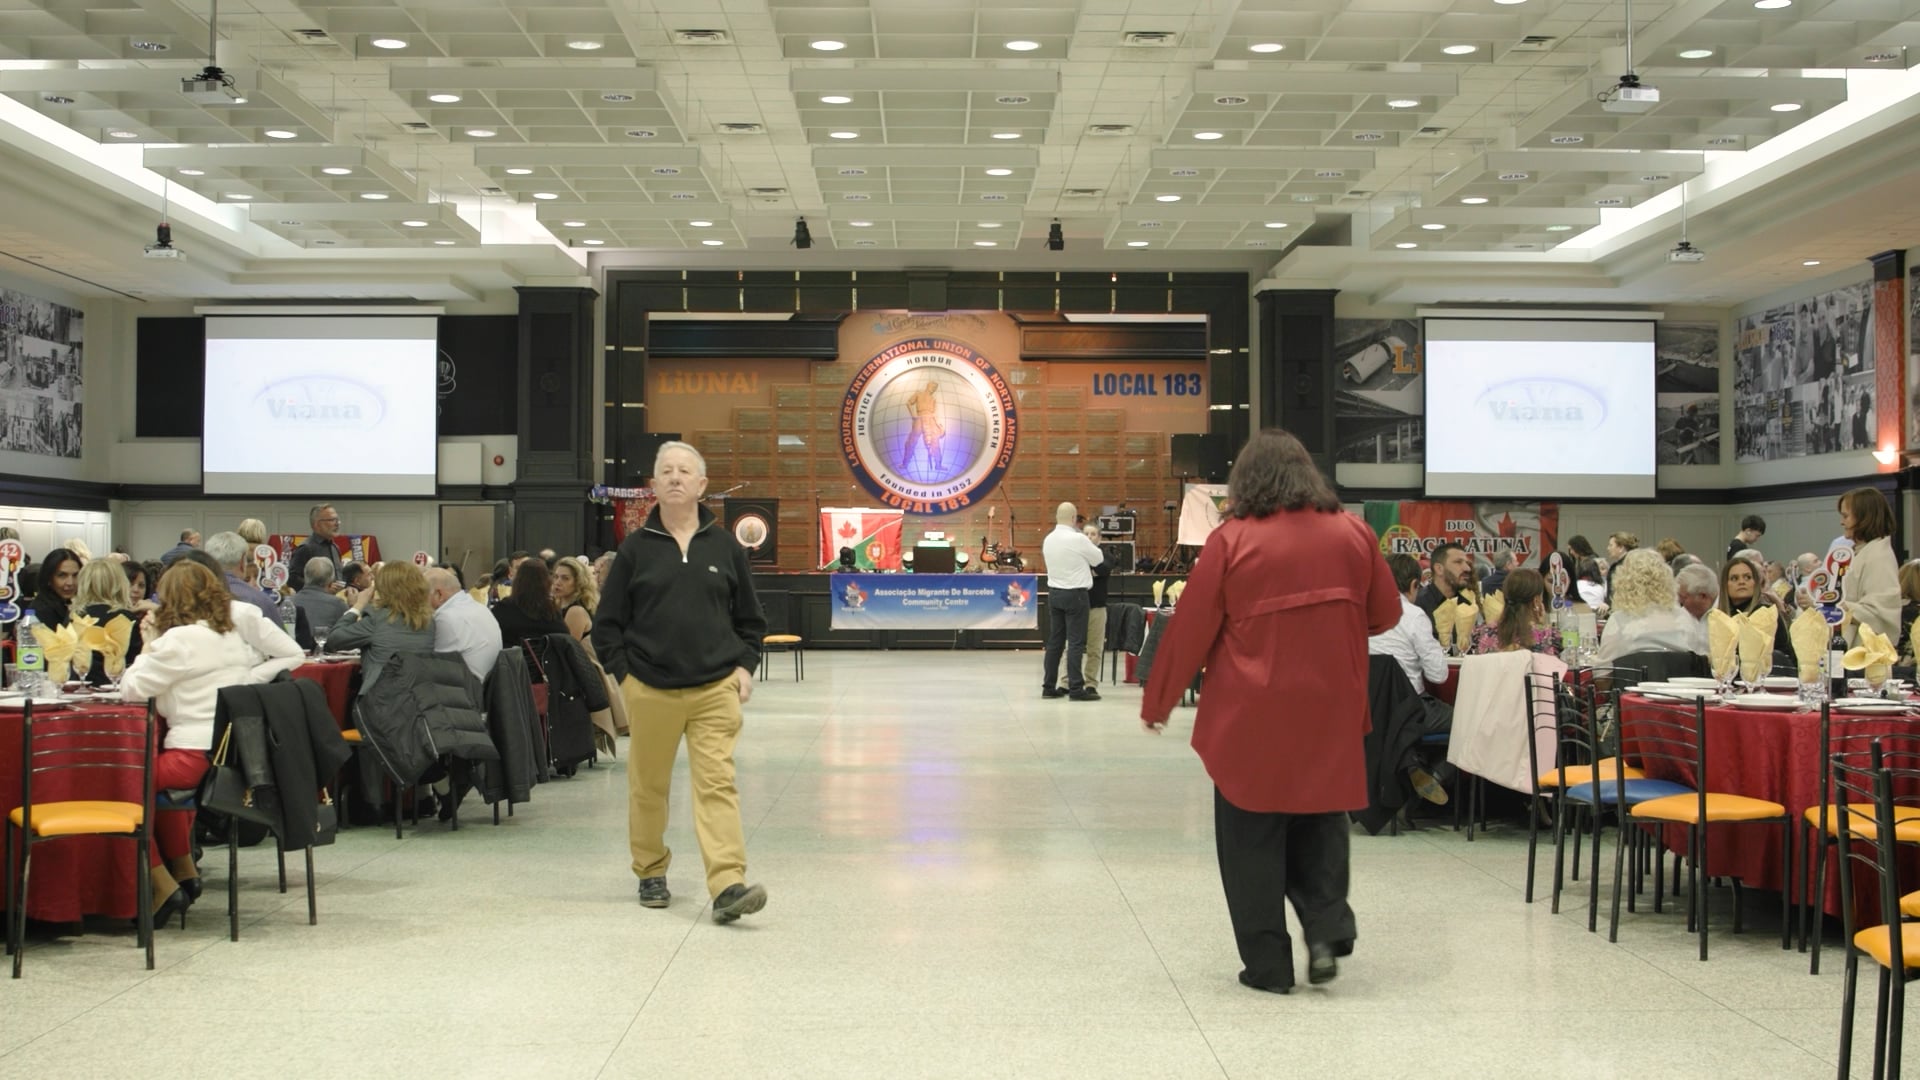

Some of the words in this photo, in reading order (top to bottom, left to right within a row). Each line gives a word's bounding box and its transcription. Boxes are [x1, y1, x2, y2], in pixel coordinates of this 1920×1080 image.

[934, 340, 972, 358] UNION
[851, 340, 930, 395] INTERNATIONAL
[907, 355, 952, 366] HONOUR
[975, 357, 992, 374] OF
[991, 373, 1014, 411] NORTH
[1093, 372, 1158, 396] LOCAL
[1163, 372, 1202, 396] 183
[266, 398, 362, 420] Viana
[1488, 399, 1585, 421] Viana
[985, 391, 1000, 450] STRENGTH
[997, 418, 1016, 469] AMERICA
[879, 473, 927, 498] Founded
[931, 490, 943, 498] in
[947, 478, 973, 495] 1952
[880, 490, 933, 513] LOCAL
[938, 494, 970, 512] 183
[1446, 520, 1475, 531] DUO
[874, 588, 917, 598] Associação
[918, 588, 950, 598] Migrante
[951, 588, 961, 596] De
[963, 588, 995, 596] Barcelos
[902, 599, 944, 608] Community
